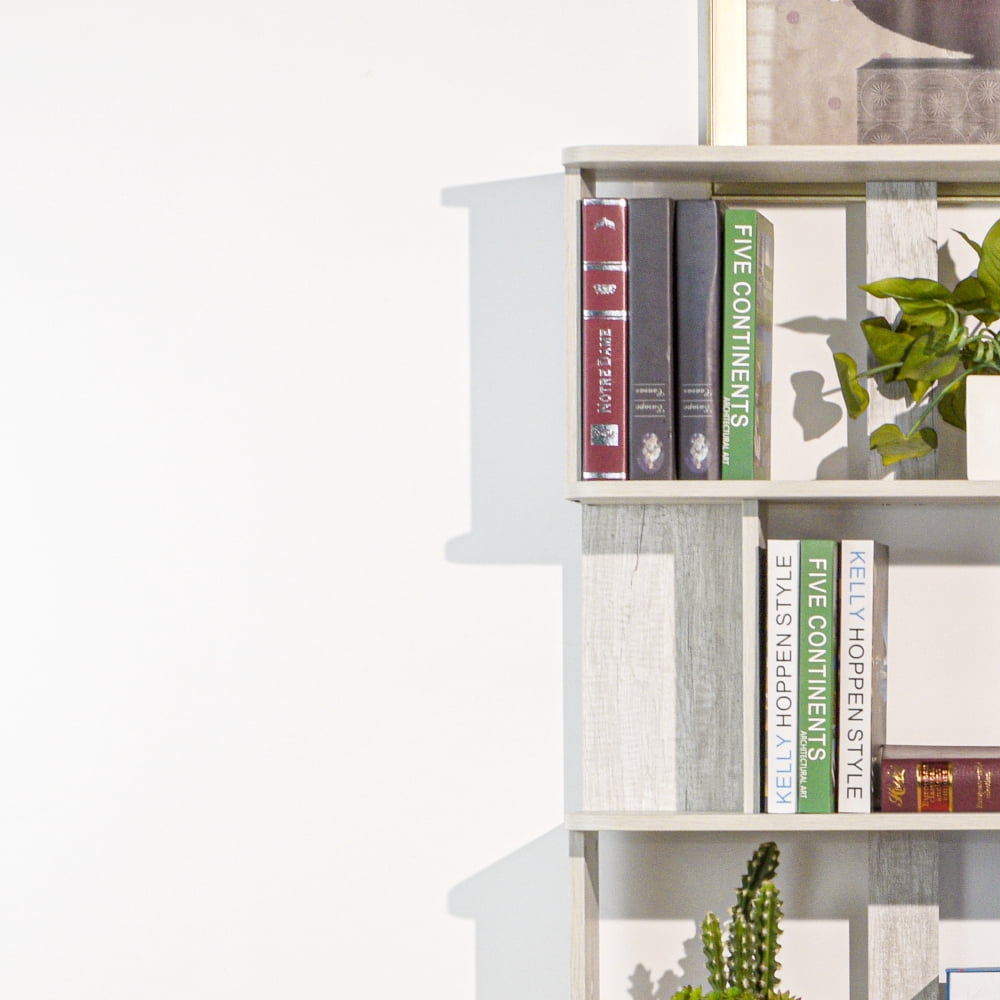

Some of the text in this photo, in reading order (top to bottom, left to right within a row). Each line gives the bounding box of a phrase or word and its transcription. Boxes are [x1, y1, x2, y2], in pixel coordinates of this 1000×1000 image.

[731, 224, 753, 428] FIVE CONTINENTS
[776, 554, 792, 805] KELLY HOPPEN STYLE
[807, 558, 827, 761] FIVE CONTINENTS
[846, 551, 866, 800] KELLY HOPPEN STYLE
